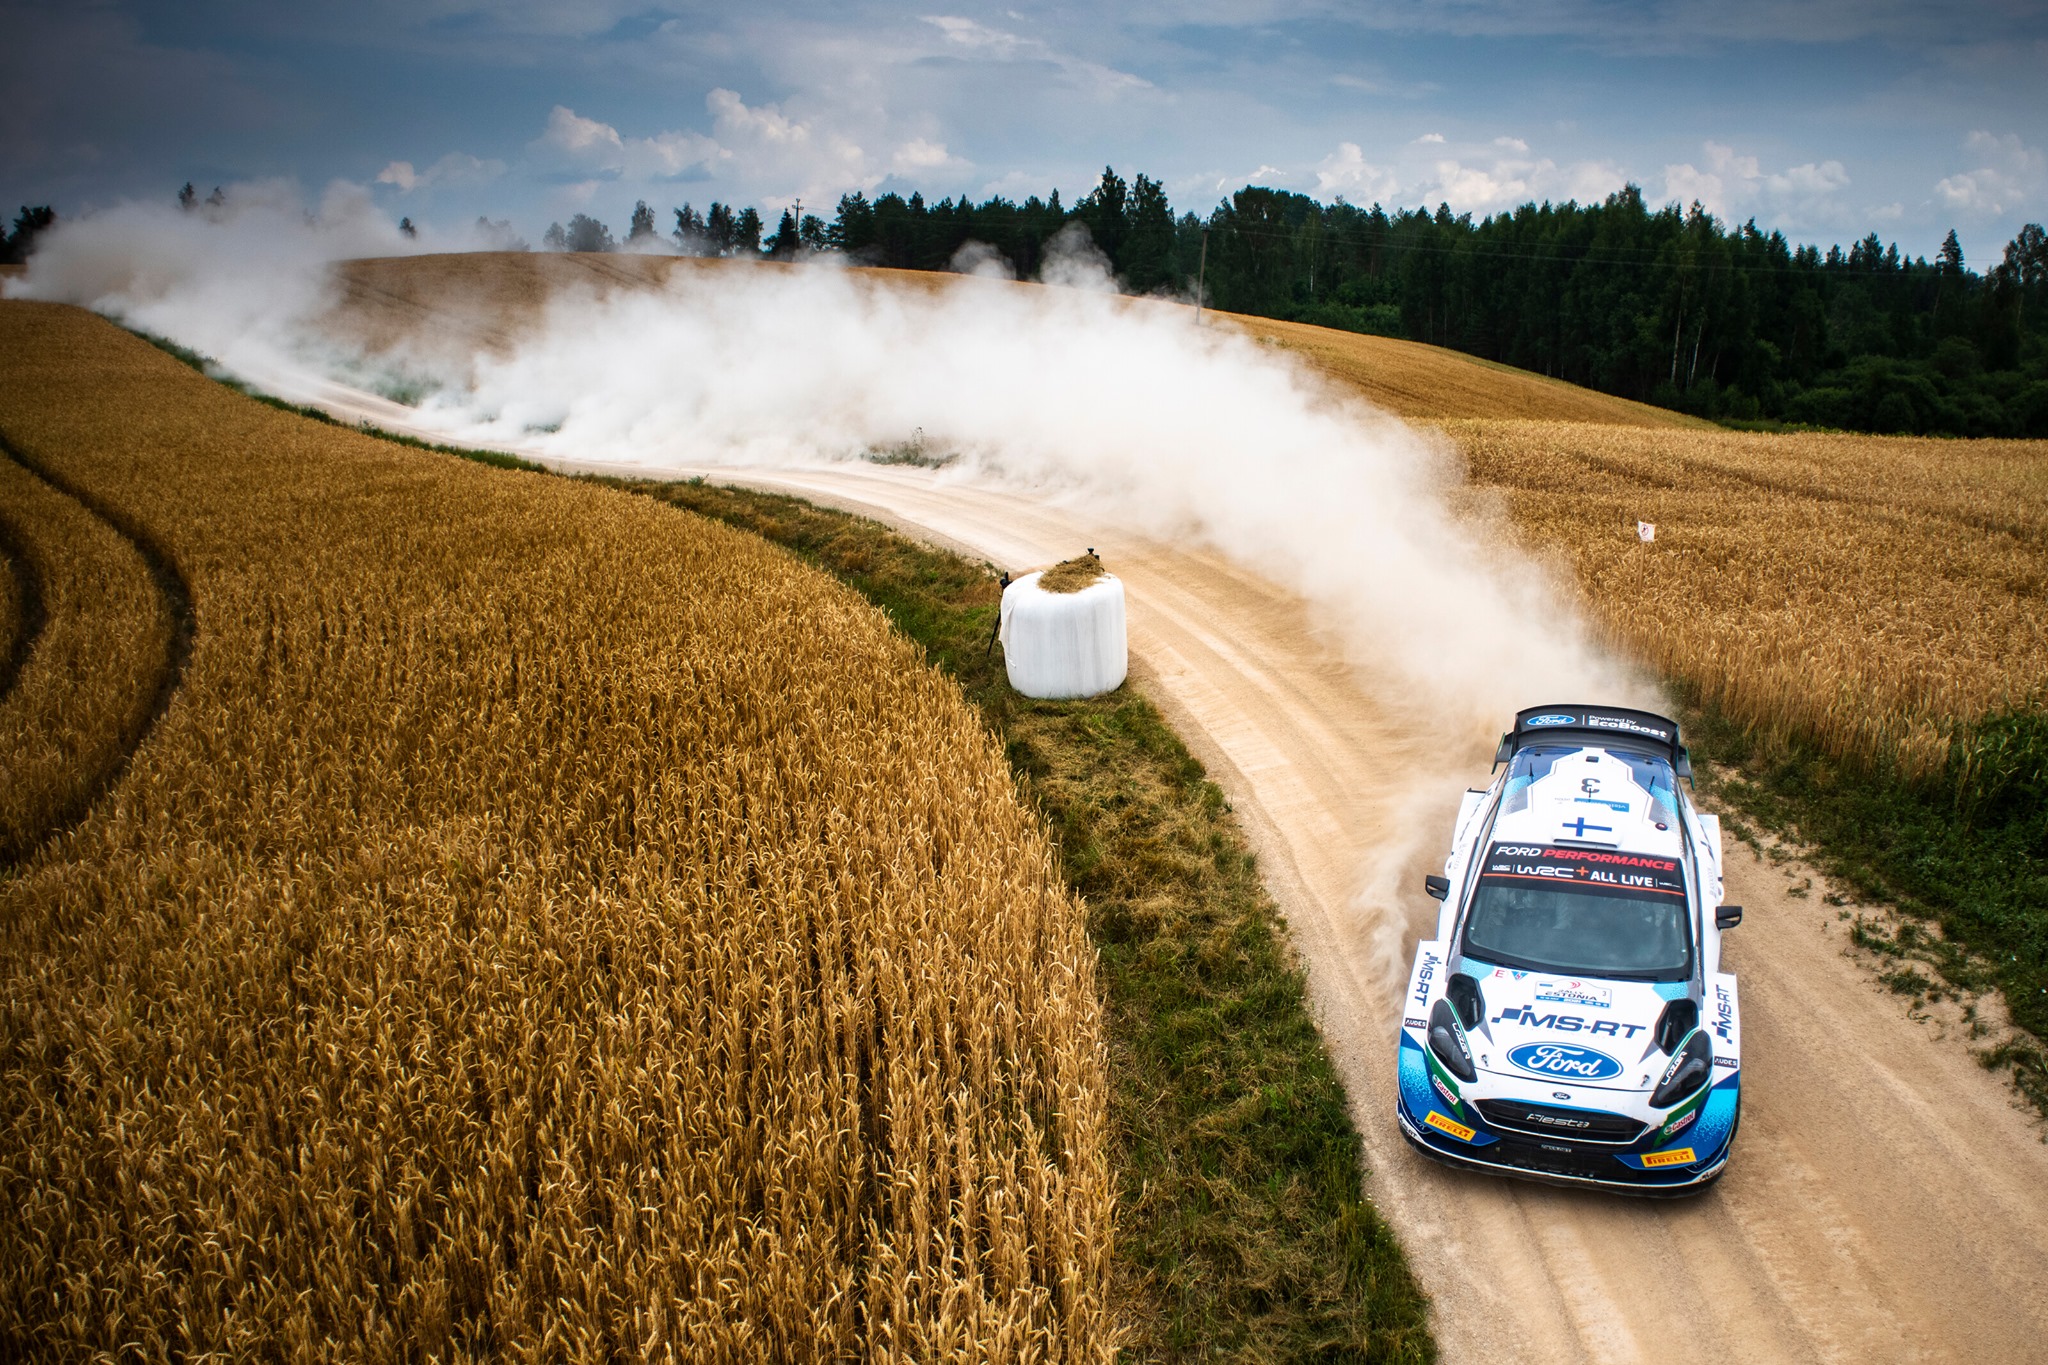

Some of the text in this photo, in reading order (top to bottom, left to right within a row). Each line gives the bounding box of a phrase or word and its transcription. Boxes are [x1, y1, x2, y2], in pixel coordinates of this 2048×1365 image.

[1536, 716, 1568, 724] Ford
[1589, 715, 1625, 723] Powered
[1589, 720, 1667, 738] EcoBoost
[1581, 778, 1600, 793] 3
[1495, 846, 1542, 857] FORD
[1542, 849, 1676, 871] PERFORMANCE
[1590, 871, 1618, 883] ALL
[1622, 874, 1653, 887] LIVE
[1519, 1011, 1646, 1039] MS-RT
[1527, 1045, 1600, 1077] Ford
[1437, 1082, 1457, 1103] Castrol
[1429, 1114, 1470, 1138] PIRELLI
[1526, 1113, 1590, 1128] Fiesta
[1672, 1111, 1695, 1131] Castrol
[1646, 1150, 1690, 1165] PIRELLI
